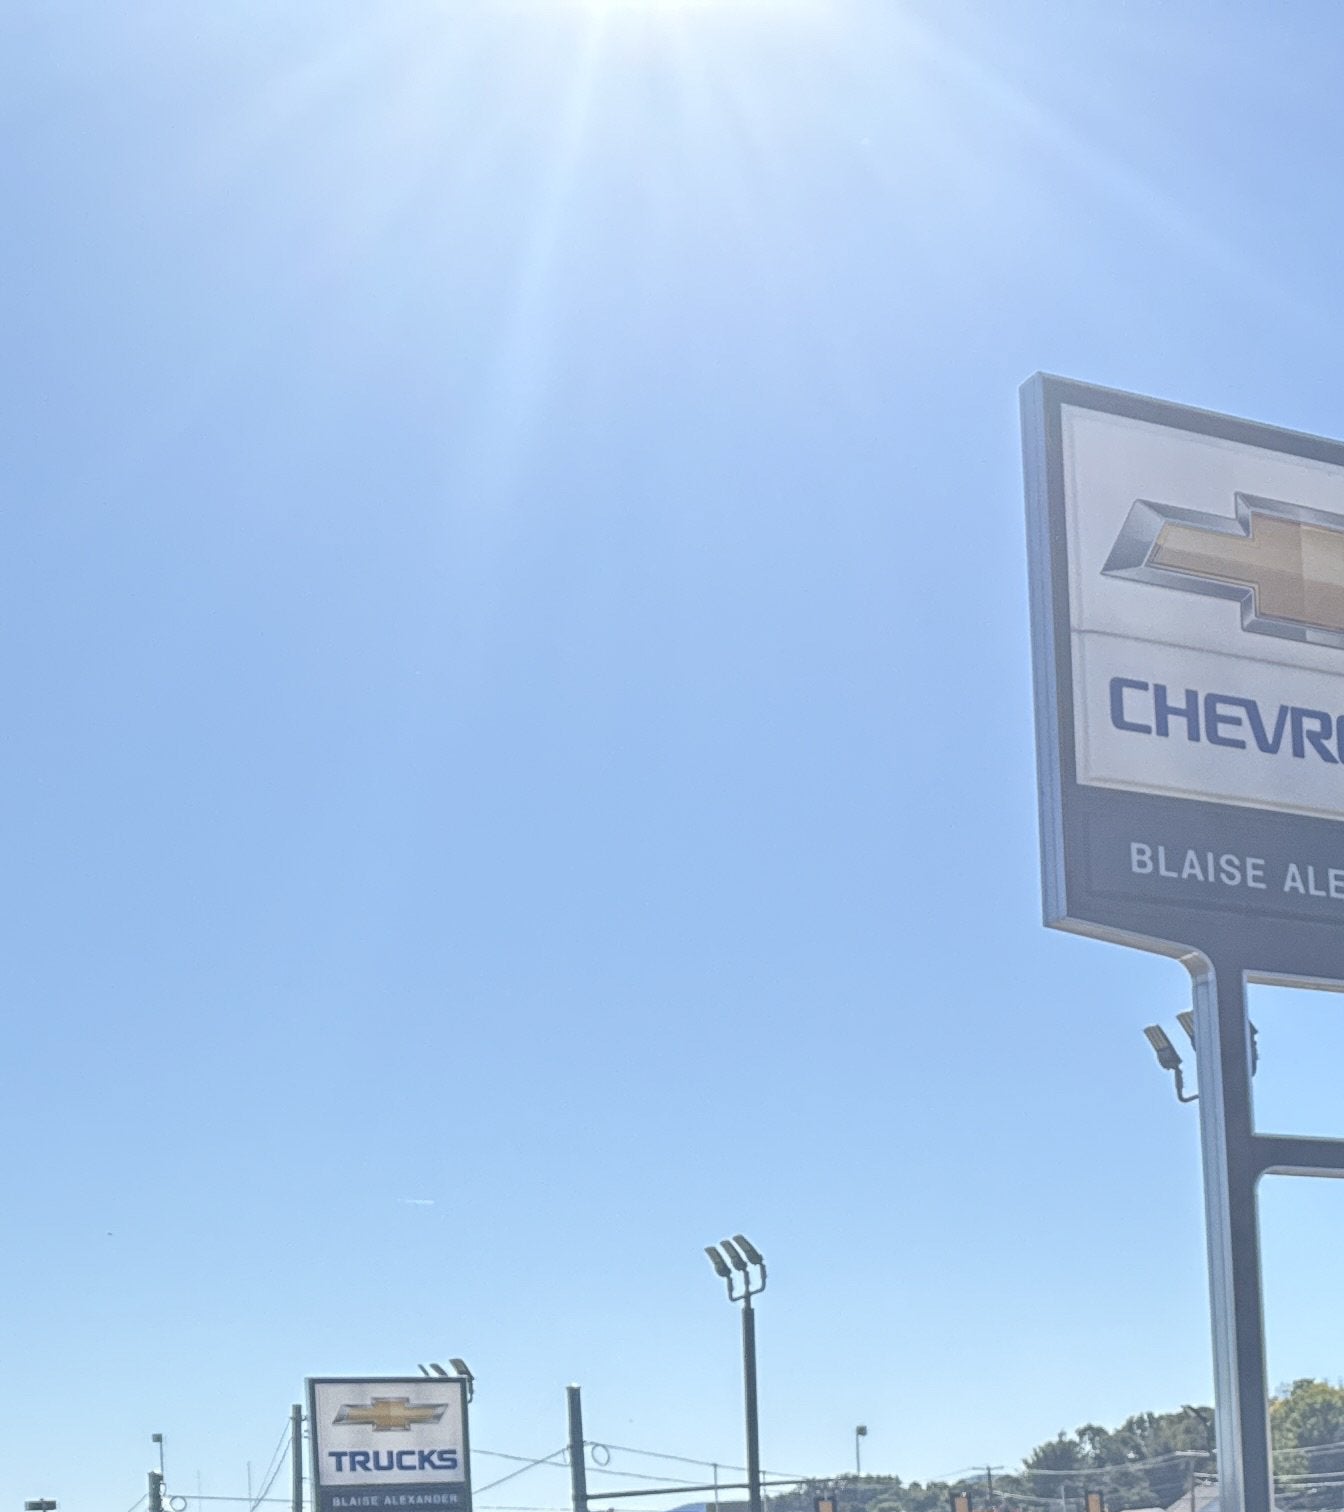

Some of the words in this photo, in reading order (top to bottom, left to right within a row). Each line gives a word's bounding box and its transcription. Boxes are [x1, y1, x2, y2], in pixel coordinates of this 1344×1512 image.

[1130, 842, 1267, 889] BLAISE
[328, 1449, 458, 1472] TRUCKS
[332, 1495, 378, 1507] BLAISE
[383, 1493, 457, 1505] ALEXANDER
